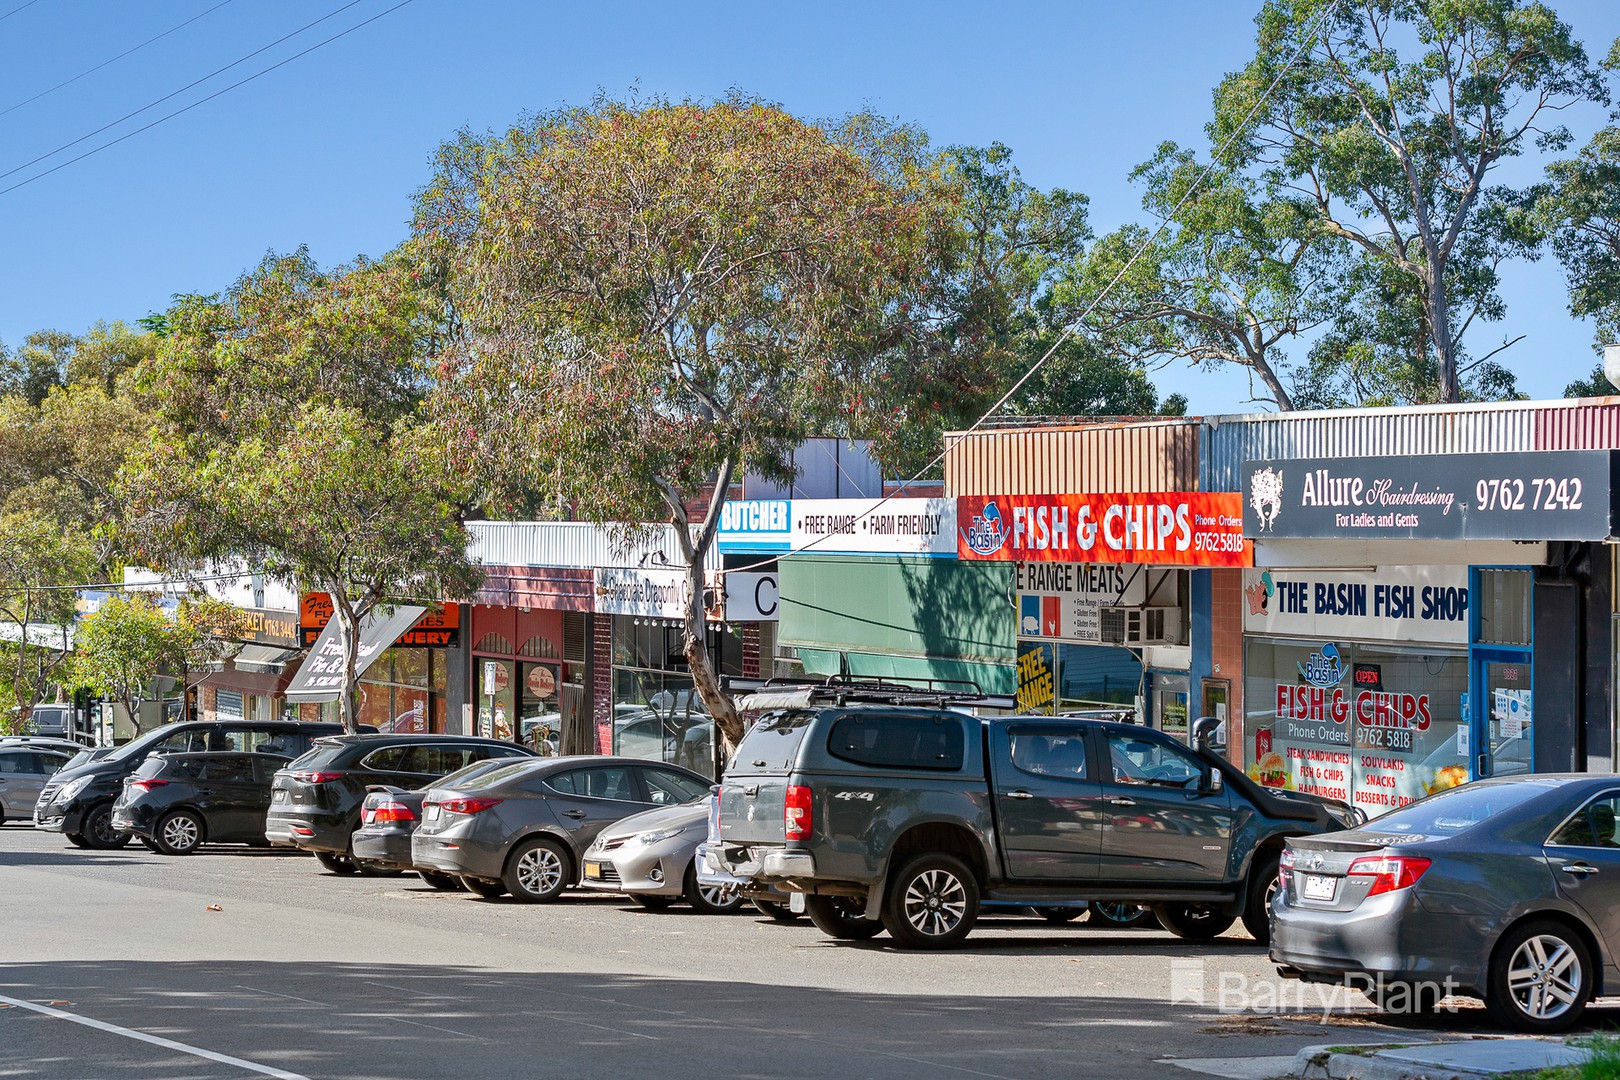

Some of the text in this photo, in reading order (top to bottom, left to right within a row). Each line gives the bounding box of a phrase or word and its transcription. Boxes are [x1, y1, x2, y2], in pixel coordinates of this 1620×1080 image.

[1302, 470, 1583, 516] Allure Hairdressing 9762 7242
[721, 501, 788, 532] BUTCHER
[805, 514, 942, 536] FREE RANGE FARM FRIENDLY
[972, 515, 991, 534] The
[1195, 514, 1243, 527] Phone Orders
[1336, 513, 1418, 528] For Ladies and Gents
[1013, 503, 1192, 551] FISH & CHIPS
[969, 526, 1002, 549] Basin
[1028, 563, 1072, 591] RANGE
[1077, 564, 1124, 594] MEATS
[306, 597, 334, 614] Fres
[1277, 582, 1469, 622] THE BASIN FISH SHOP
[319, 637, 343, 656] Fres
[1016, 645, 1047, 685] FREE
[1310, 653, 1330, 669] The
[1305, 663, 1340, 683] Basin
[1355, 669, 1378, 684] OPEN
[1016, 671, 1055, 715] RANGE
[1275, 684, 1432, 733] FISH & CHIPS
[1288, 723, 1410, 749] Phone Orders 9762 5818
[1287, 747, 1350, 765] STEAK SANDWICHES
[1361, 755, 1404, 771] SOUVLAKIS
[1300, 766, 1344, 782] FISH & CHIPS
[1365, 775, 1396, 789] SNACKS
[1298, 784, 1347, 800] HAMBURGERS
[1355, 791, 1389, 806] DESSERTS
[1391, 794, 1396, 807] &
